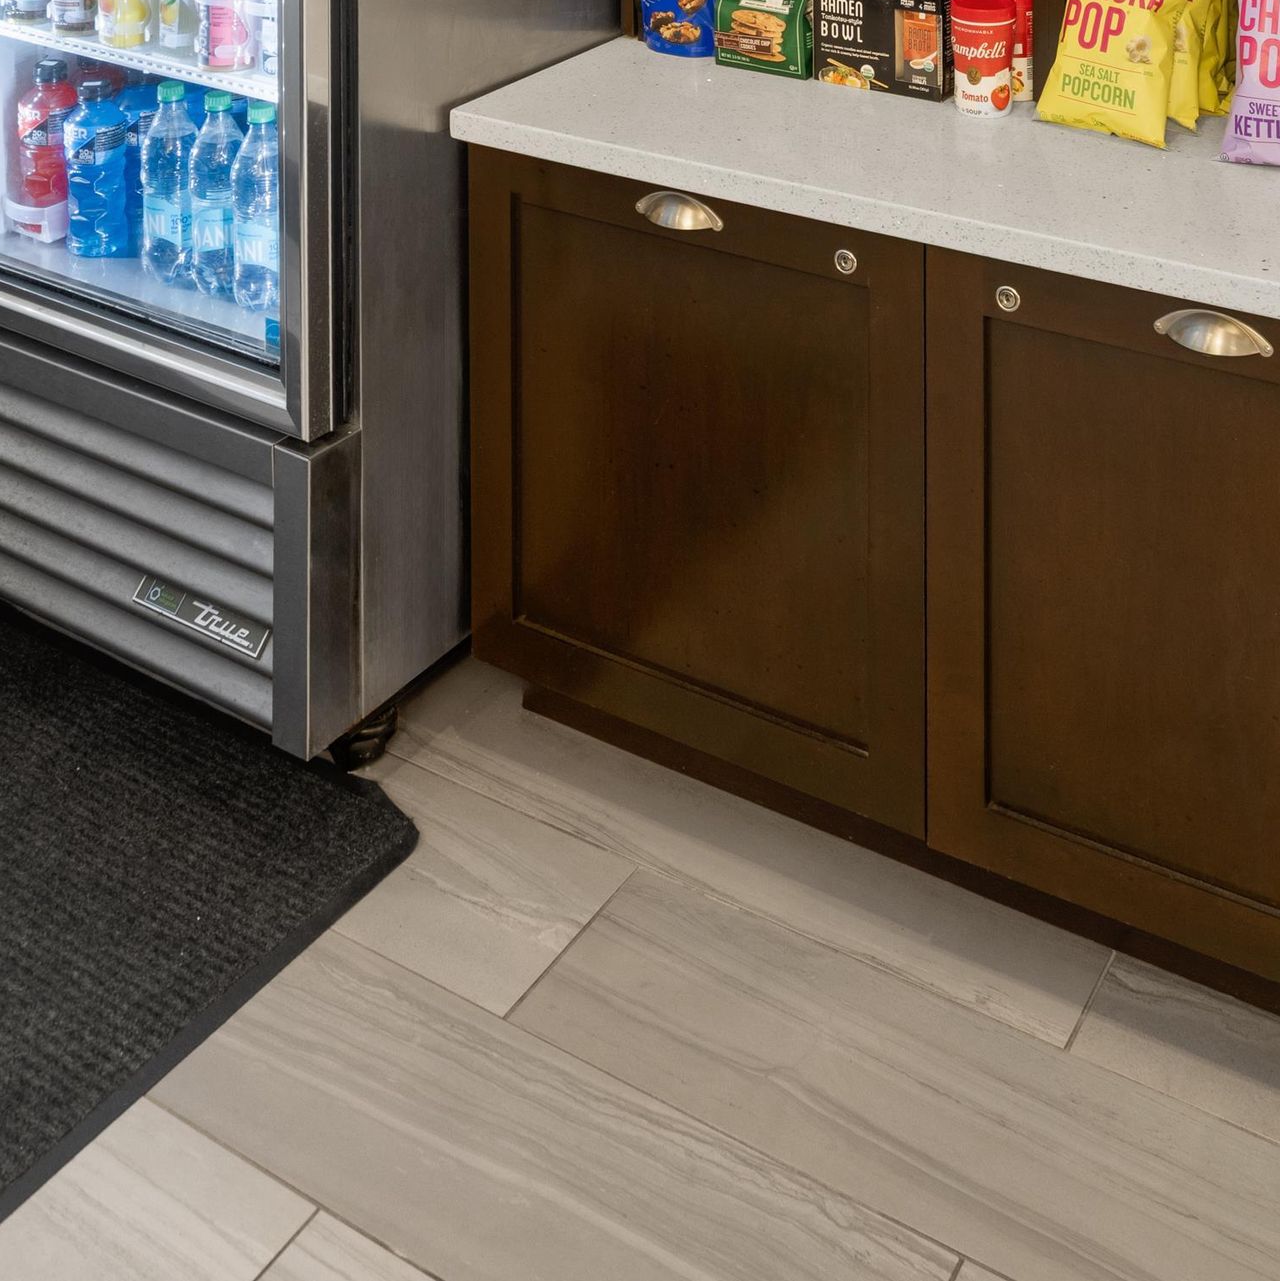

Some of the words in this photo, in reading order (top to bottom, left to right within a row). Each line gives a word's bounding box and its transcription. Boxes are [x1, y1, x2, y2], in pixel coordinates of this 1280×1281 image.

[739, 38, 760, 46] CHOCOLATE
[821, 21, 863, 42] BOWL
[1079, 63, 1095, 78] SEA
[1097, 67, 1120, 84] SALT
[961, 91, 988, 102] Tomato
[1061, 73, 1136, 110] POPCORN
